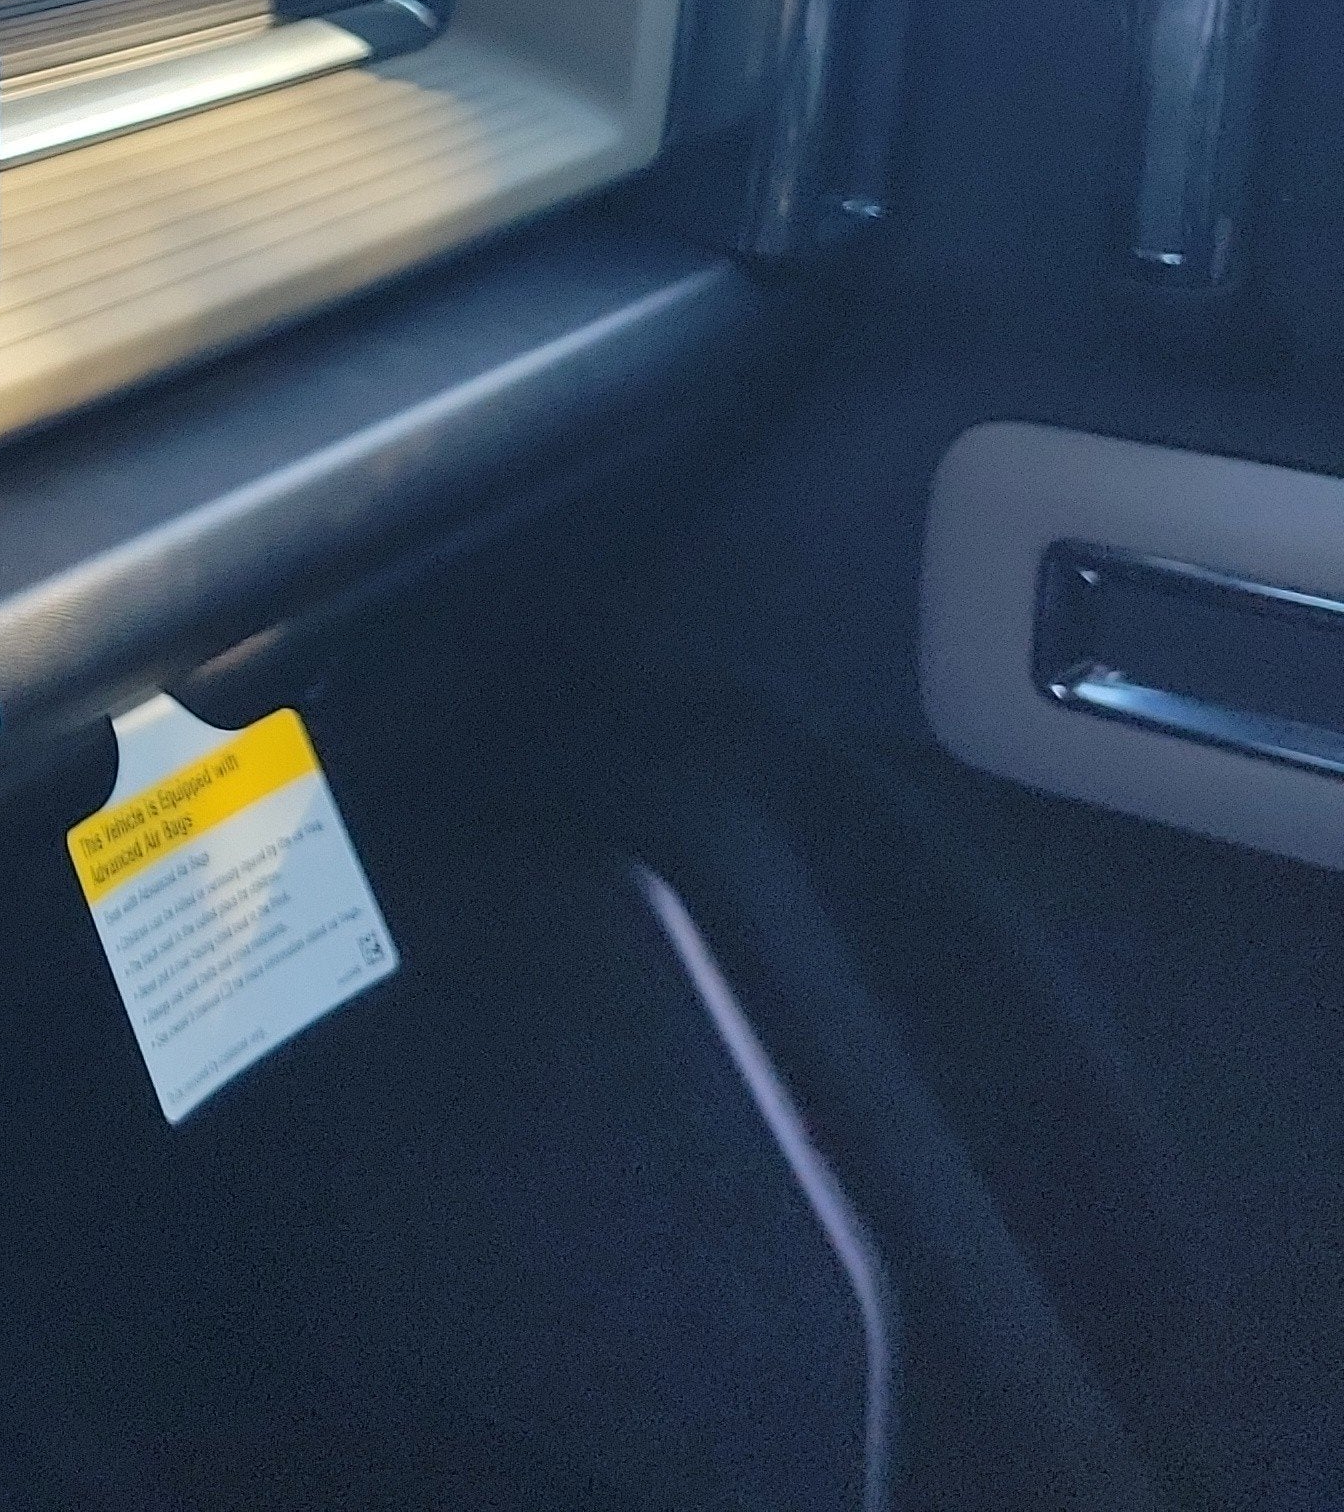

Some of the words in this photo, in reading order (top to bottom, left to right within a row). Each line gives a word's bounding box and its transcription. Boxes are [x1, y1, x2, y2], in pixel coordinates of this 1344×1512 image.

[156, 767, 213, 811] Equipped
[89, 840, 145, 885] Advanced
[142, 829, 163, 854] Air
